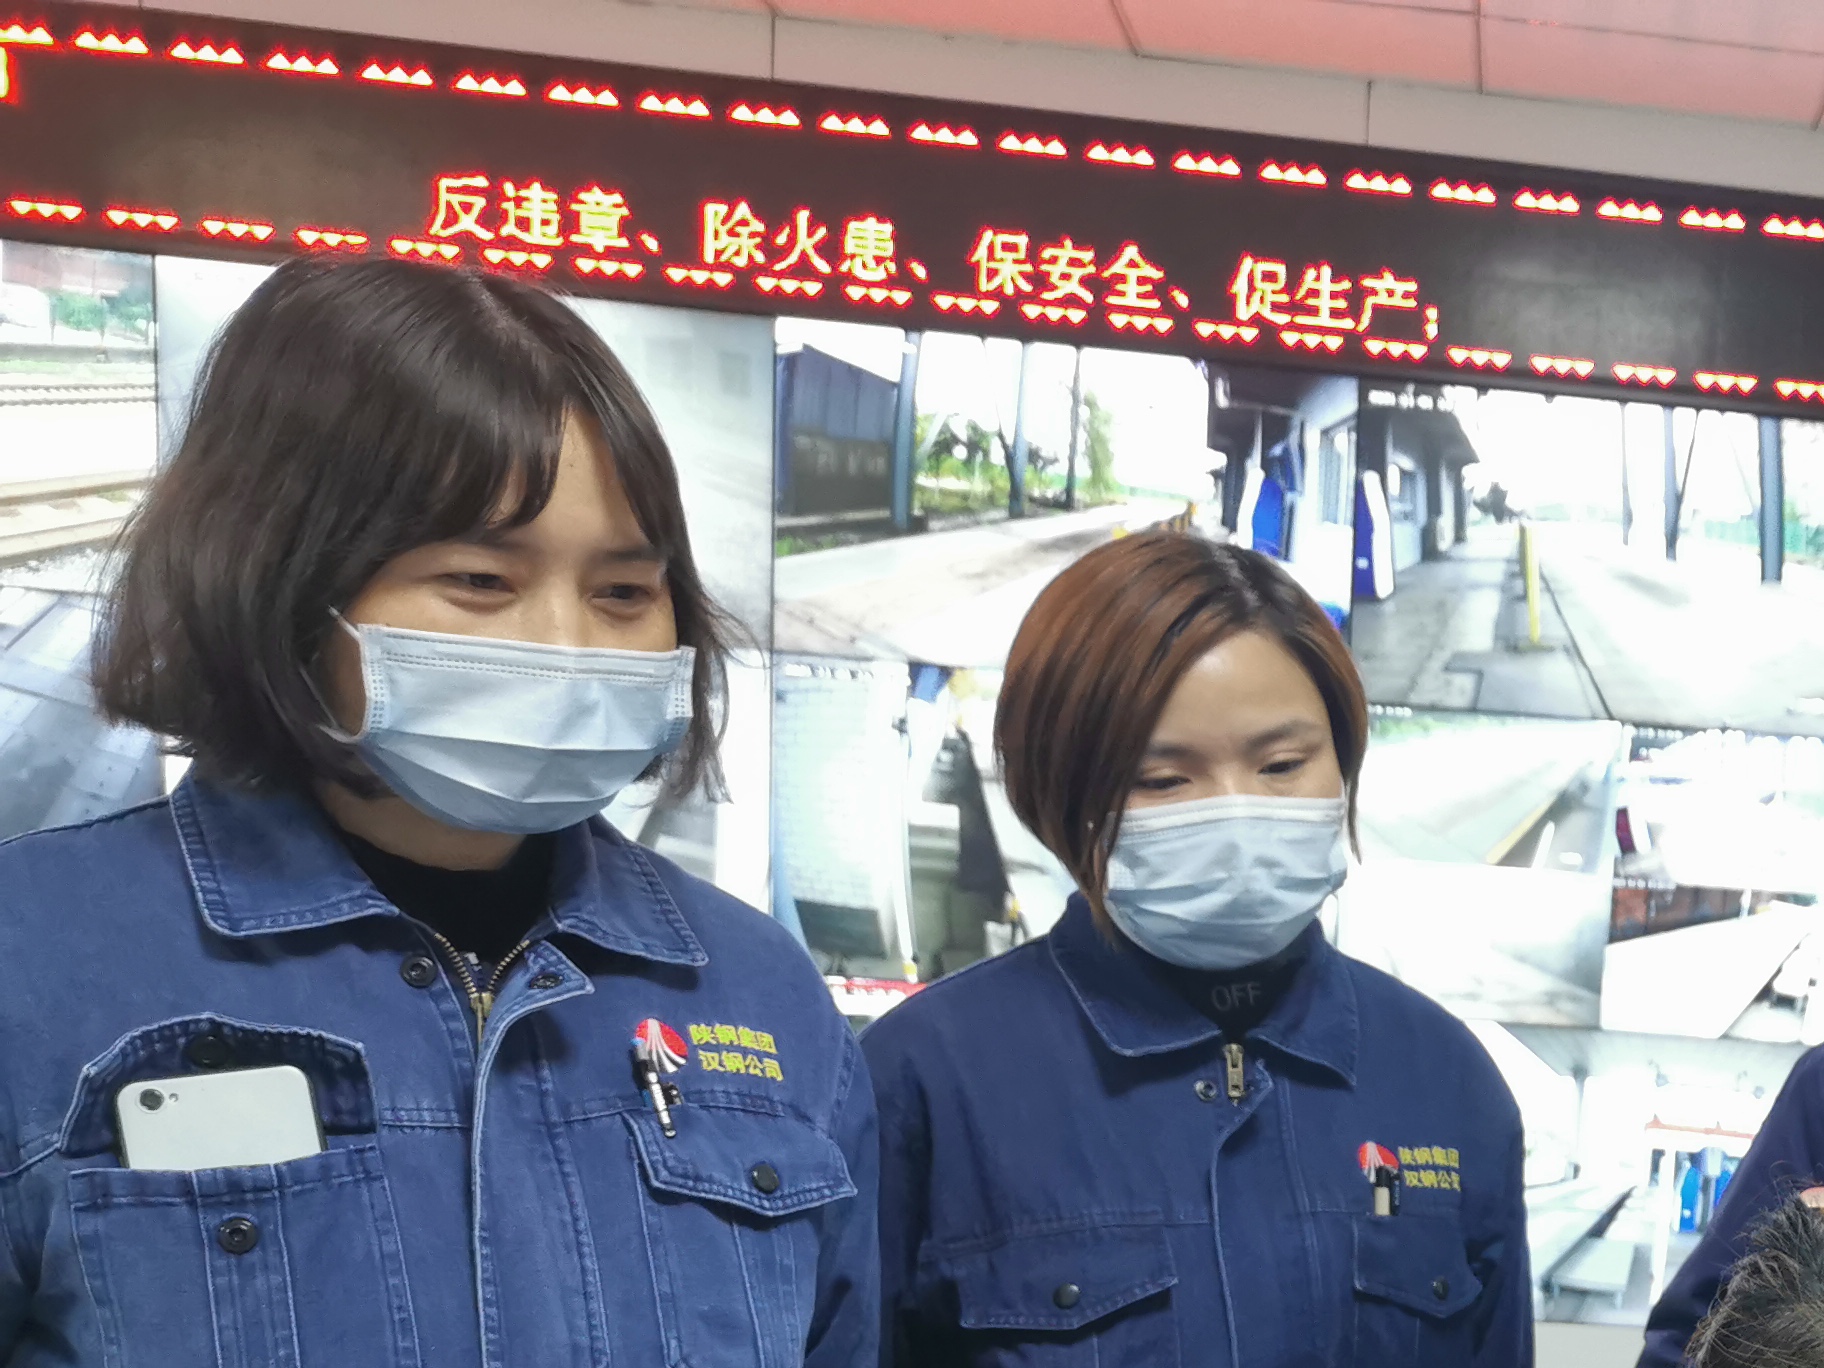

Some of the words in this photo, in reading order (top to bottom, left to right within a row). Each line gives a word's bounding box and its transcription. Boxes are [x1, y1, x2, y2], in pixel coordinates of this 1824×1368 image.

[1211, 982, 1261, 1011] OFF
[688, 1023, 778, 1054] 陕钢集团
[698, 1050, 785, 1082] 汉钢公司
